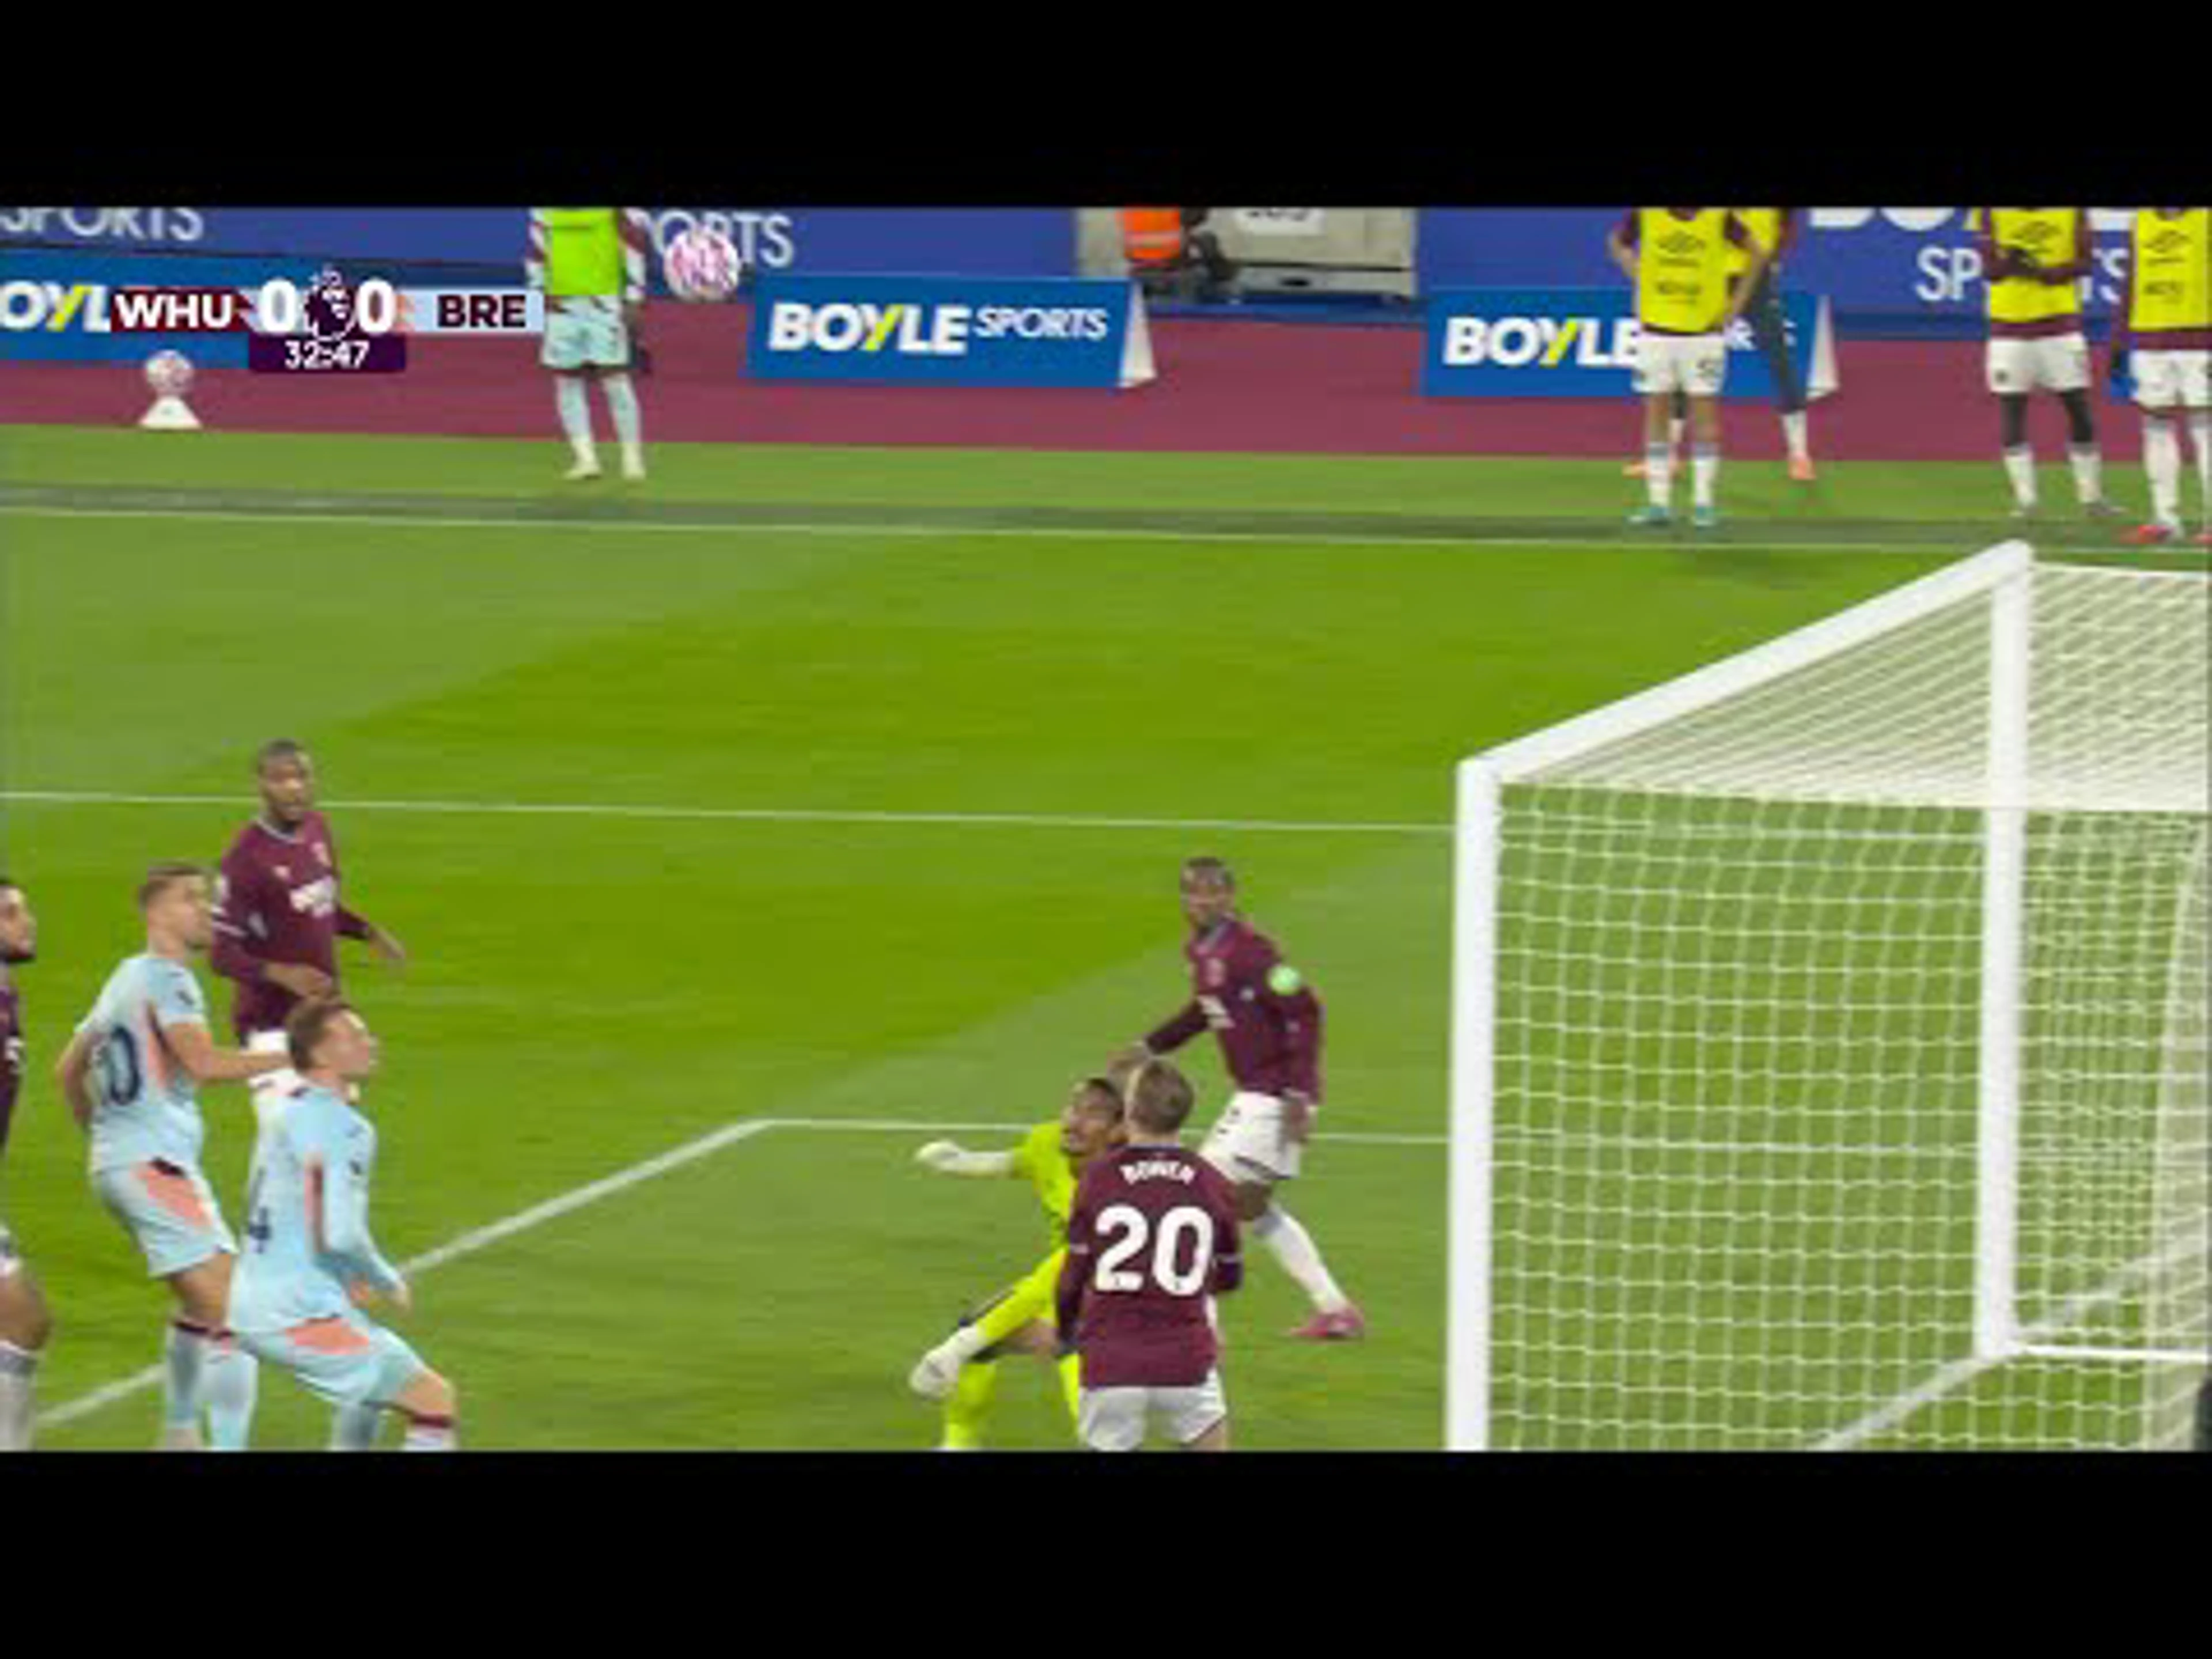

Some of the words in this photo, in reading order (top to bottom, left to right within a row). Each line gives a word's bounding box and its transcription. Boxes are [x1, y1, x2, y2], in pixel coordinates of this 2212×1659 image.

[769, 301, 972, 354] BOYLE
[974, 307, 1109, 340] SPORTS
[1096, 1204, 1214, 1296] 20
